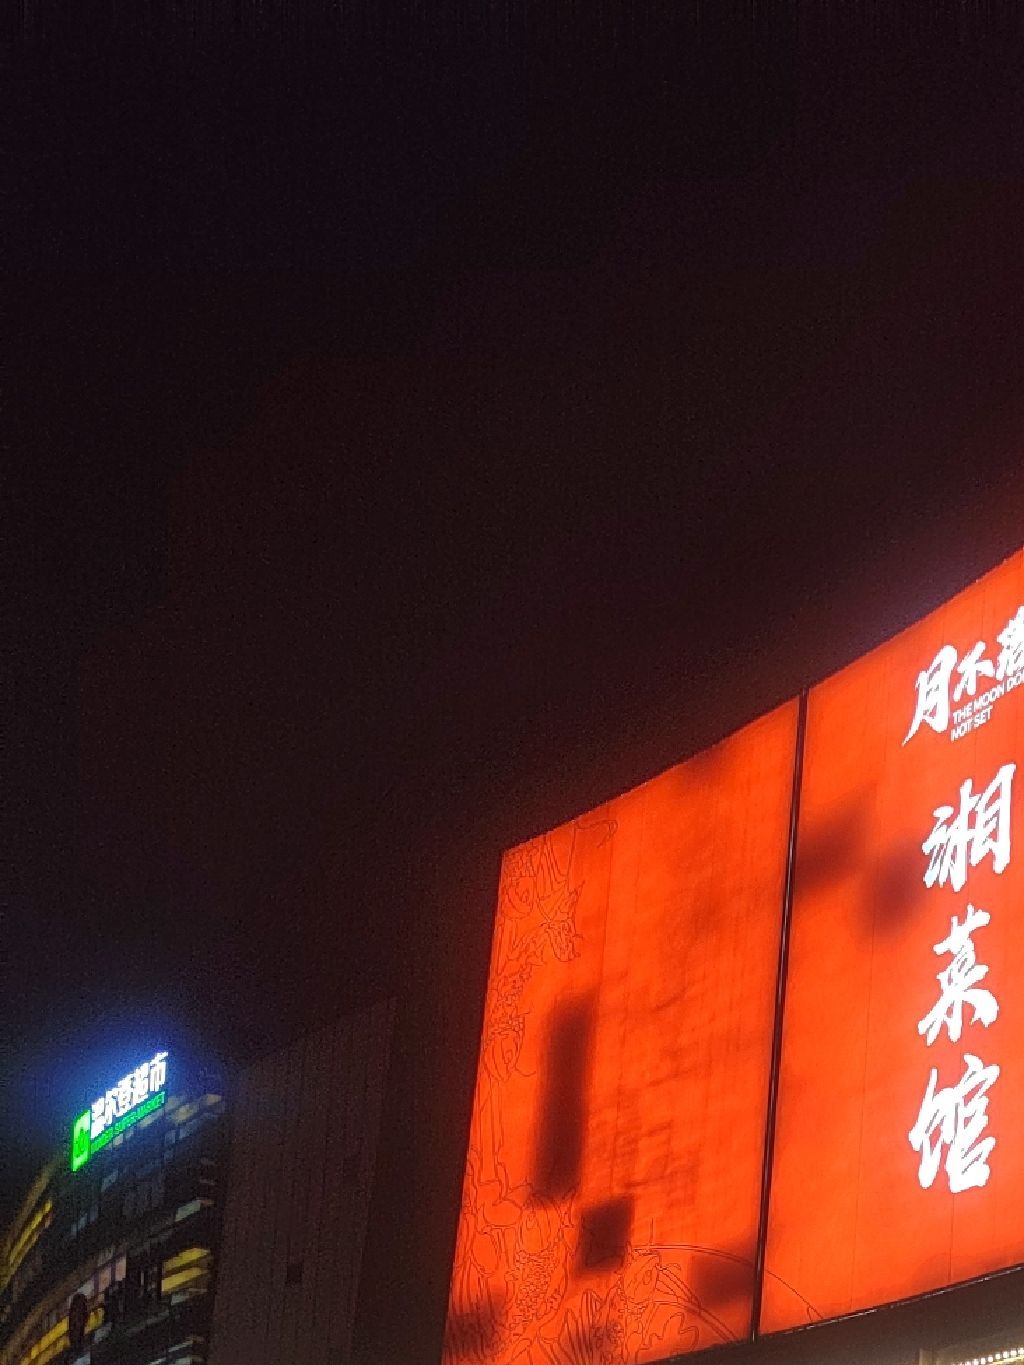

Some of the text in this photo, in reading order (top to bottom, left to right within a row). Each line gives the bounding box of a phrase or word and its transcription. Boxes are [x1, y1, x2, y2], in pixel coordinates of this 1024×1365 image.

[951, 706, 993, 742] NOT SET
[953, 702, 972, 724] THE
[974, 682, 1004, 711] MOON
[909, 763, 1016, 1193] 湘菜馆
